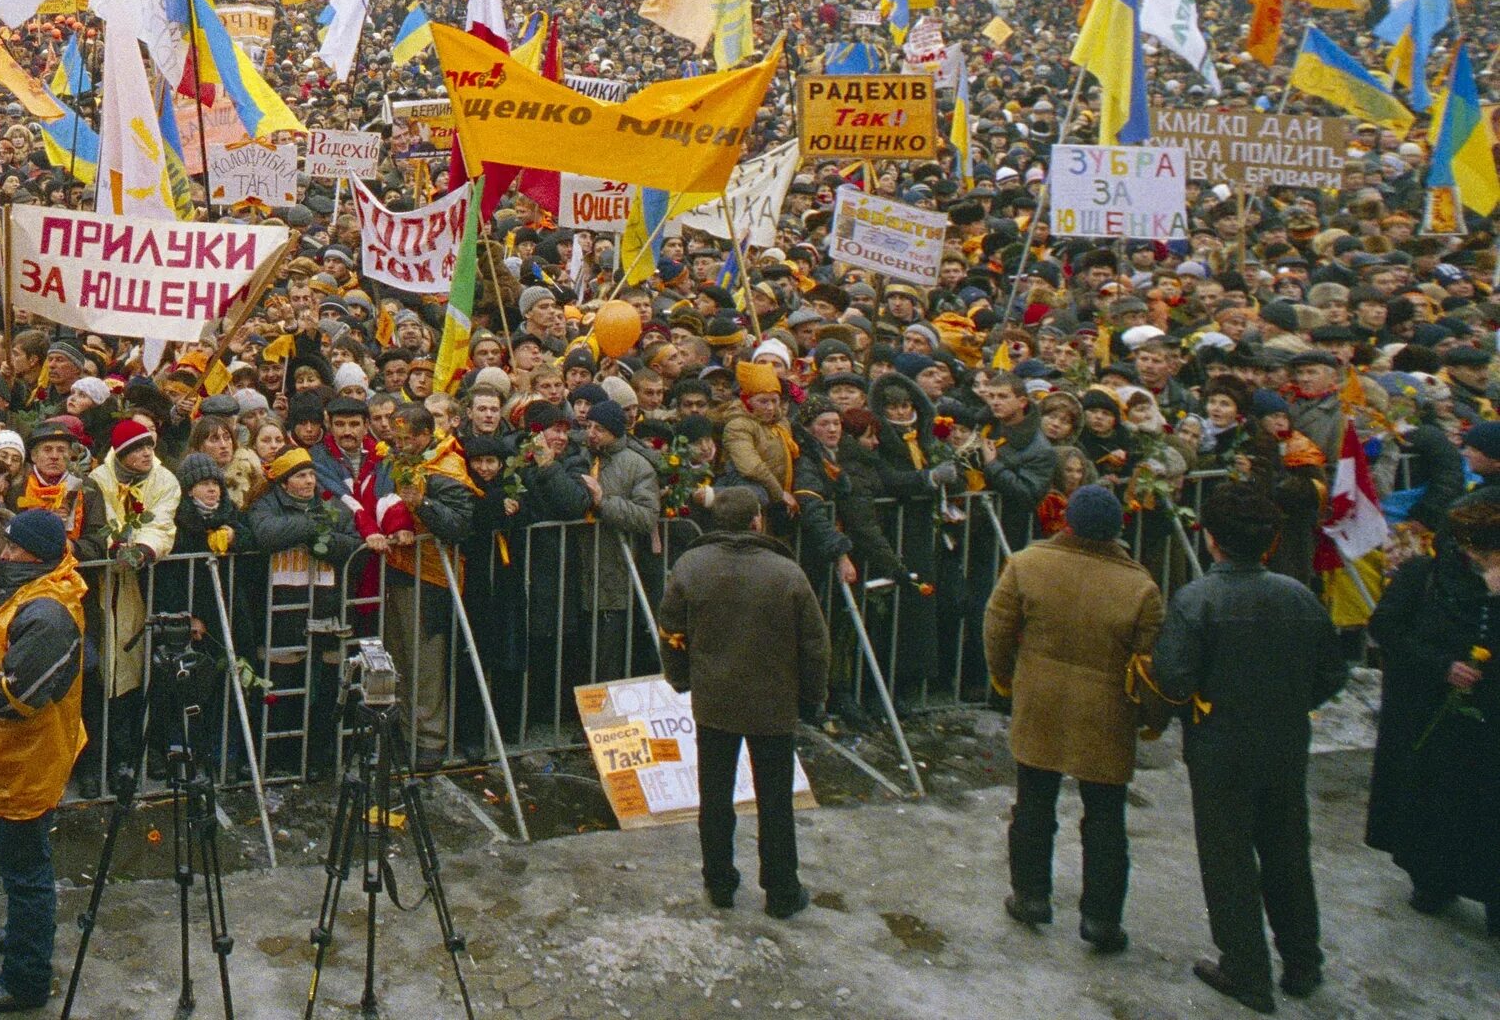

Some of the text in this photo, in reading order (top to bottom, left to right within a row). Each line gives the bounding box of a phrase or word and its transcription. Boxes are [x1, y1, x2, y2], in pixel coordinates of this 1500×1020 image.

[809, 82, 927, 103] РАДЕХІВ
[464, 97, 592, 126] щенко
[835, 108, 905, 128] Так!
[1257, 116, 1323, 141] ДАЙ
[809, 134, 926, 152] ЮЩЕНКО
[1069, 149, 1176, 178] ЗУБРА
[1244, 167, 1341, 189] БРОВАРИ
[1092, 180, 1132, 206] ЗА
[40, 216, 257, 271] ПРИЛУКИ
[19, 259, 67, 304] ЗА
[593, 726, 640, 744] Одесса
[603, 737, 652, 770] Так!
